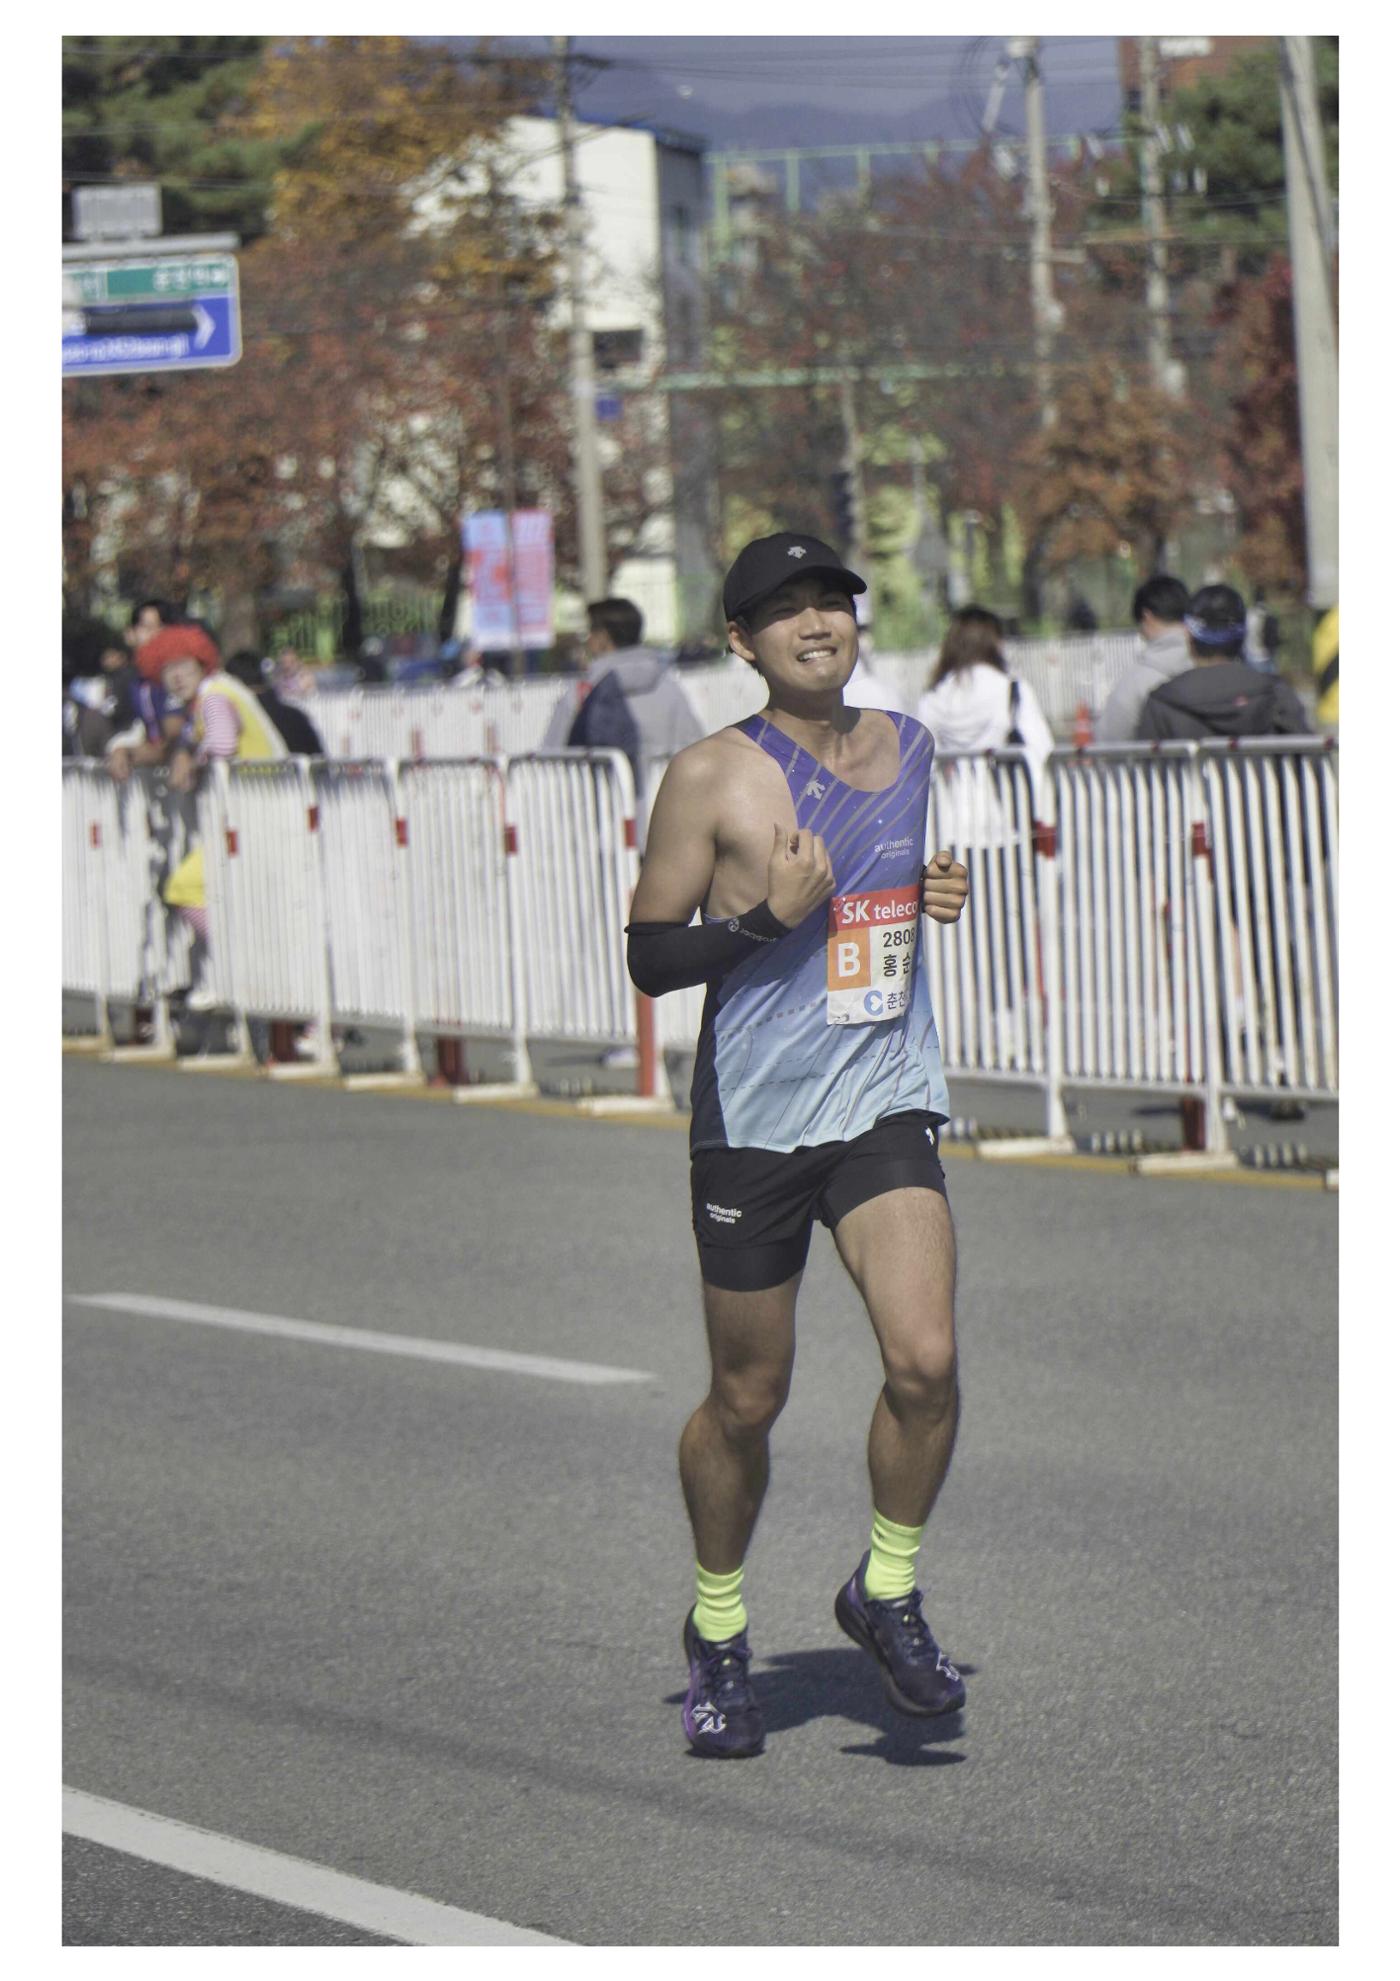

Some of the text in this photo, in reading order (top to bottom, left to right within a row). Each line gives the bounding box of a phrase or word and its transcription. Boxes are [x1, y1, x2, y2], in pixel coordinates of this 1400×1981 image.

[841, 899, 871, 924] SK
[837, 942, 861, 977] B
[886, 990, 912, 1009] 춘천
[706, 1203, 742, 1217] authentic
[709, 1212, 736, 1224] originals
